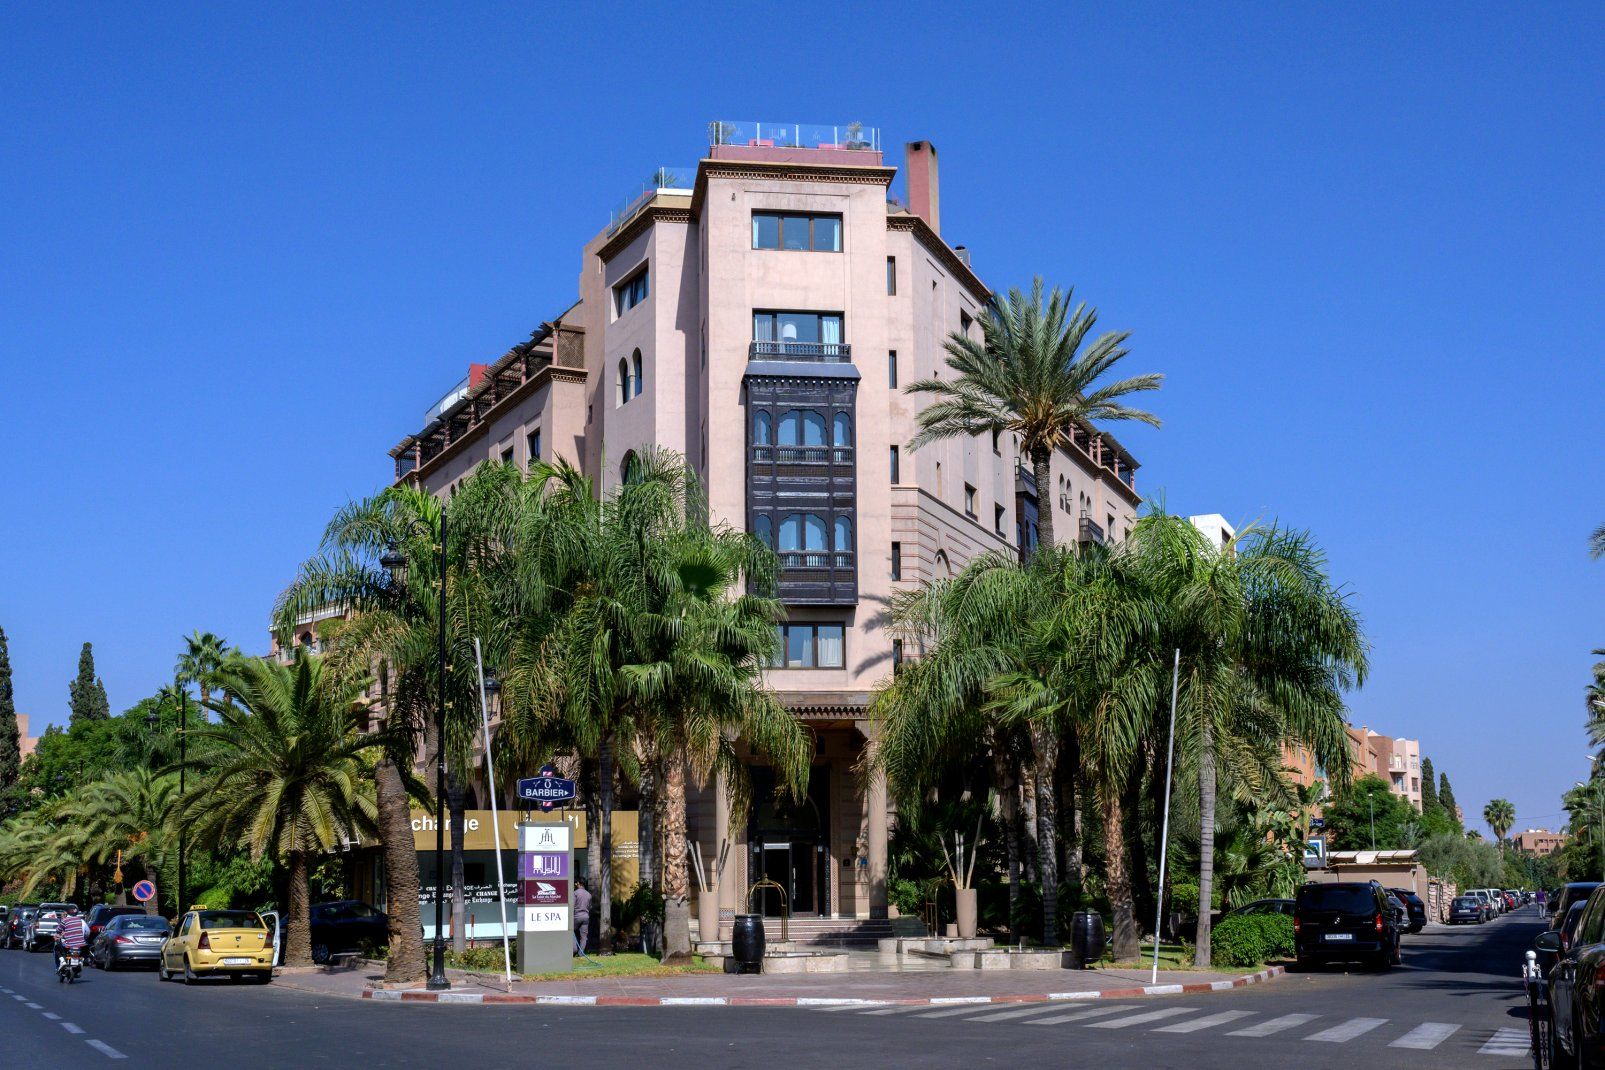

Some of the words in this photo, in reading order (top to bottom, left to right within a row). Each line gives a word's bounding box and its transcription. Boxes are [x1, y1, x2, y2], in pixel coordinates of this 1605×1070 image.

[525, 788, 564, 797] BARBIER
[411, 815, 479, 834] chne
[531, 912, 542, 921] LE
[544, 912, 562, 921] SPA
